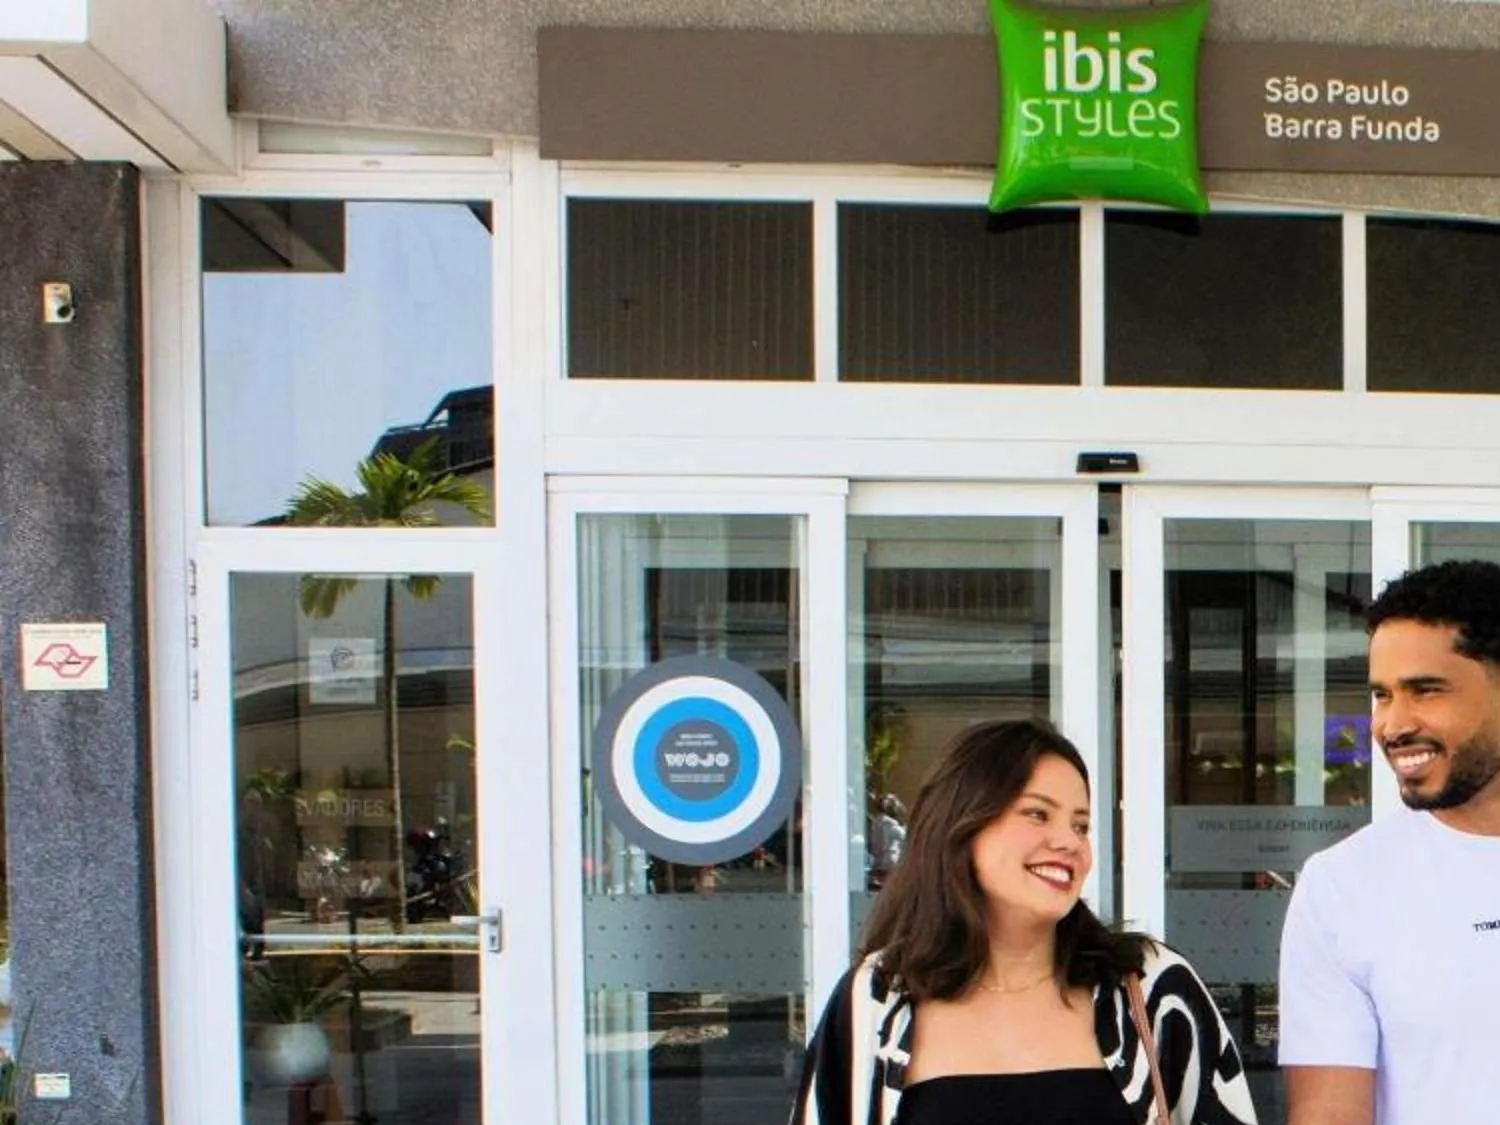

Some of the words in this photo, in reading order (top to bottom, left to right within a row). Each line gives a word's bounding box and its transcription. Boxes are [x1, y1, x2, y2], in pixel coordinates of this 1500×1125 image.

[1043, 31, 1157, 92] ibis
[1265, 77, 1319, 103] São
[1327, 80, 1410, 106] Paulo
[1265, 114, 1343, 140] Barra
[1350, 116, 1440, 142] Funda
[664, 752, 730, 768] WOJO
